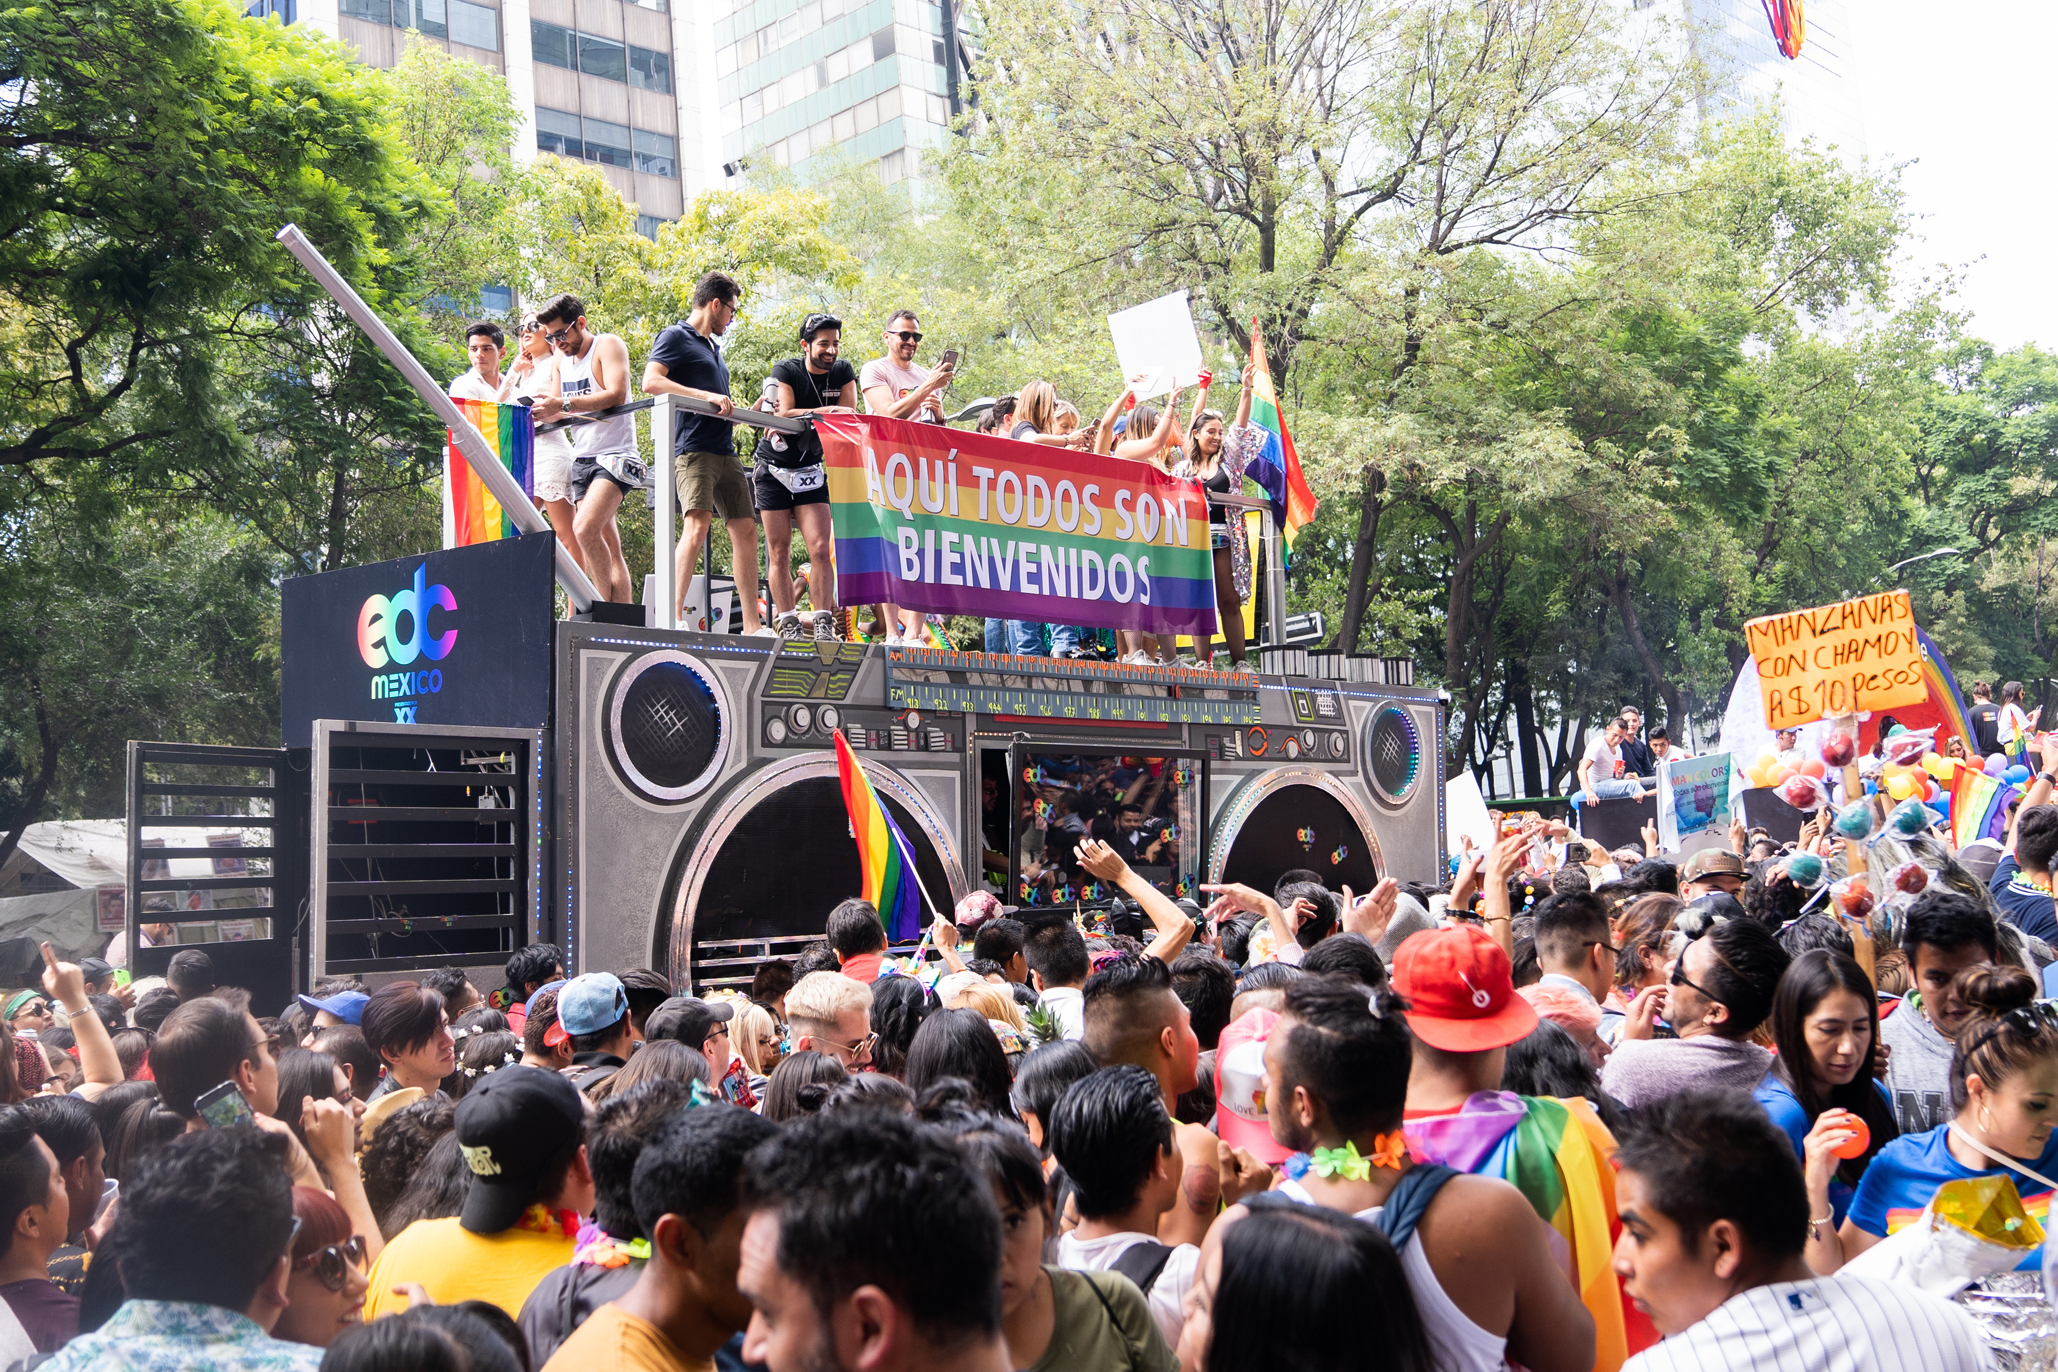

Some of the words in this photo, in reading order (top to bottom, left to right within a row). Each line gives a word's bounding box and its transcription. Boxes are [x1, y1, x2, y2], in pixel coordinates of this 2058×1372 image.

[799, 476, 817, 486] XX
[866, 448, 959, 521] AQUÍ
[972, 466, 1102, 536] TODOS
[1115, 488, 1189, 546] SON
[897, 526, 1152, 606] BIENVENIDOS
[357, 562, 458, 669] edc
[1749, 594, 1908, 653] MANZANAS
[889, 651, 903, 661] AM
[1168, 667, 1177, 676] 122
[1179, 669, 1187, 677] 123
[1189, 669, 1198, 677] 124
[1200, 670, 1209, 679] 125
[1757, 650, 1808, 678] CON
[1814, 627, 1913, 669] CHAMOY
[372, 668, 442, 700] MEXICO
[394, 706, 417, 724] XX
[891, 689, 904, 700] FM
[1138, 711, 1146, 720] 101
[1160, 713, 1169, 722] 102
[1182, 714, 1190, 723] 103
[1694, 765, 1728, 782] COLORS
[1234, 1102, 1254, 1116] LOVE
